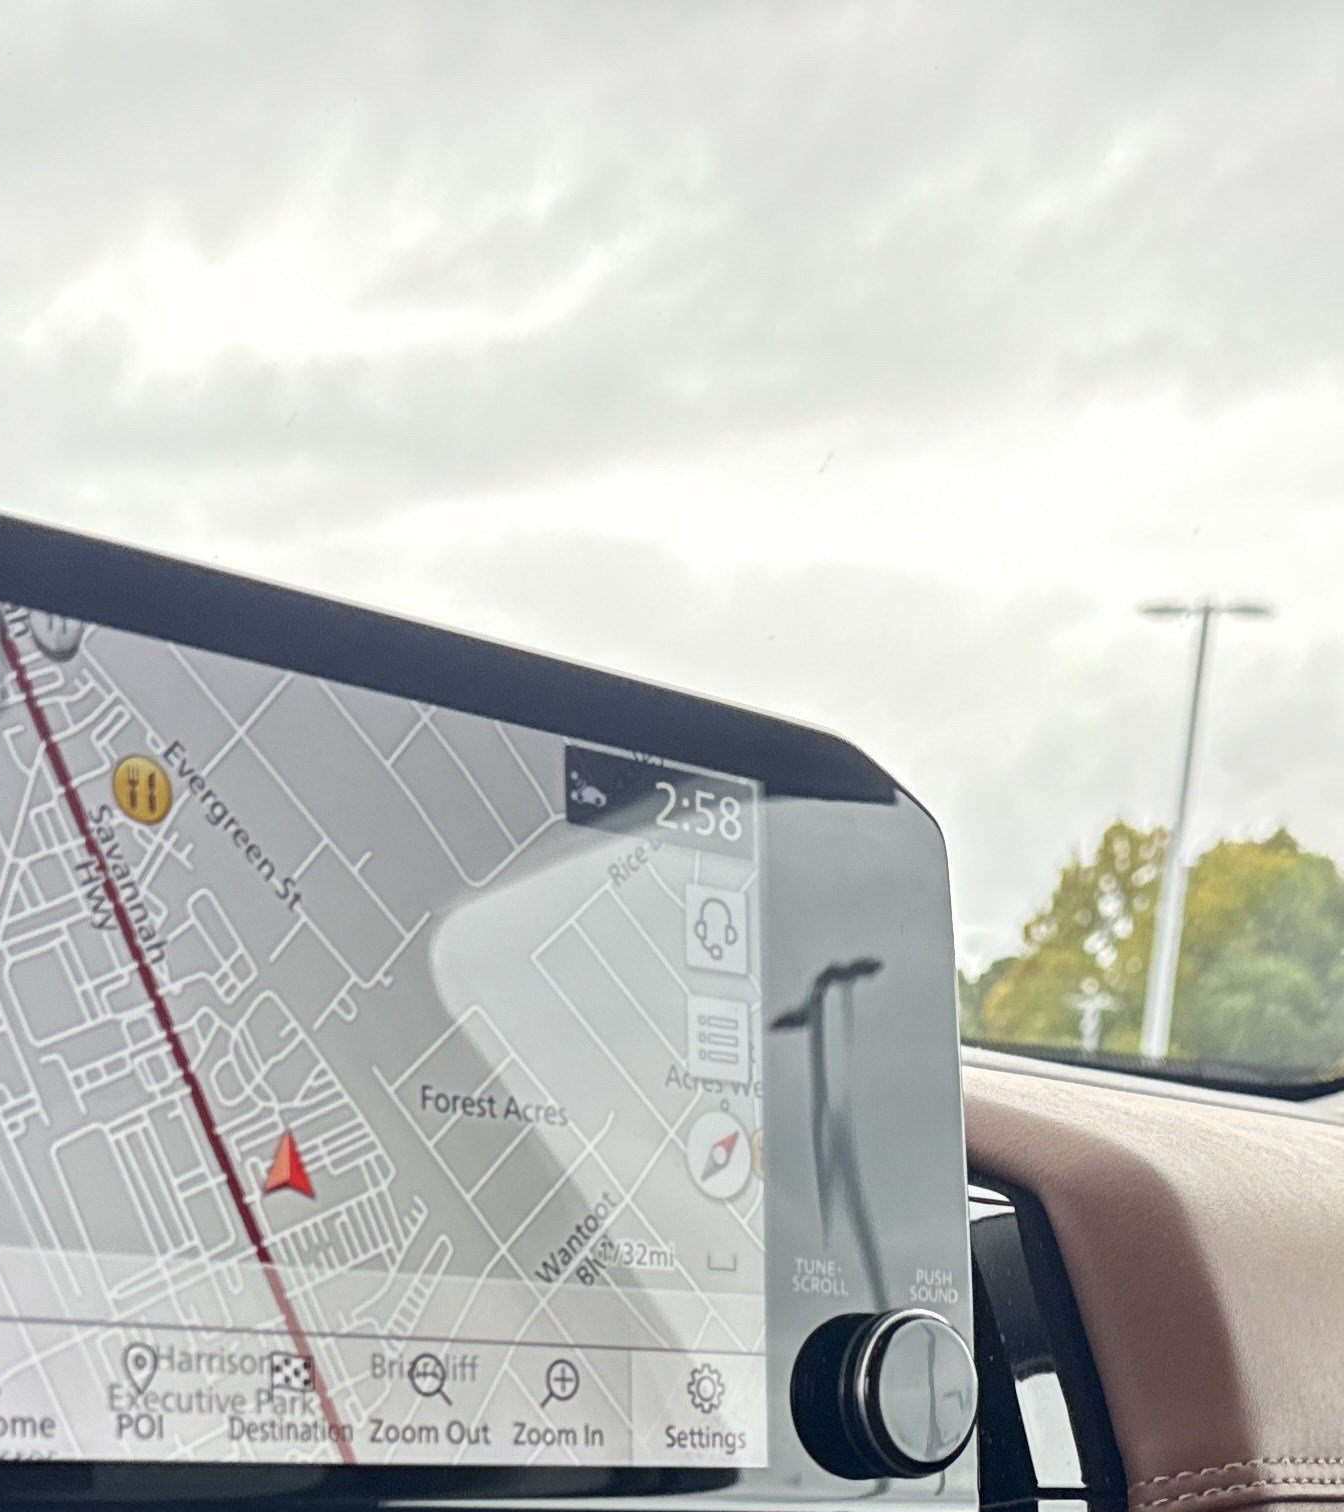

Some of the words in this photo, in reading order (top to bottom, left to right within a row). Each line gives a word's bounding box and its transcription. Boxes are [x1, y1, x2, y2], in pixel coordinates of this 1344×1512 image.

[163, 740, 275, 882] Evergreen
[276, 876, 302, 910] St
[656, 781, 743, 842] 2:58
[74, 860, 118, 931] Hwy
[88, 804, 168, 964] Savannah
[420, 1084, 497, 1120] Forest
[502, 1094, 568, 1127] Acres
[791, 1275, 850, 1297] SCROLL
[915, 1268, 953, 1287] PUSH
[909, 1284, 958, 1304] SOUND
[106, 1382, 248, 1415] Executive
[116, 1412, 165, 1440] POI
[229, 1414, 354, 1443] Destination
[369, 1417, 439, 1446] Zoom
[445, 1419, 492, 1446] Out
[512, 1421, 578, 1447] Zoom
[583, 1423, 605, 1448] In
[665, 1425, 747, 1454] Settings
